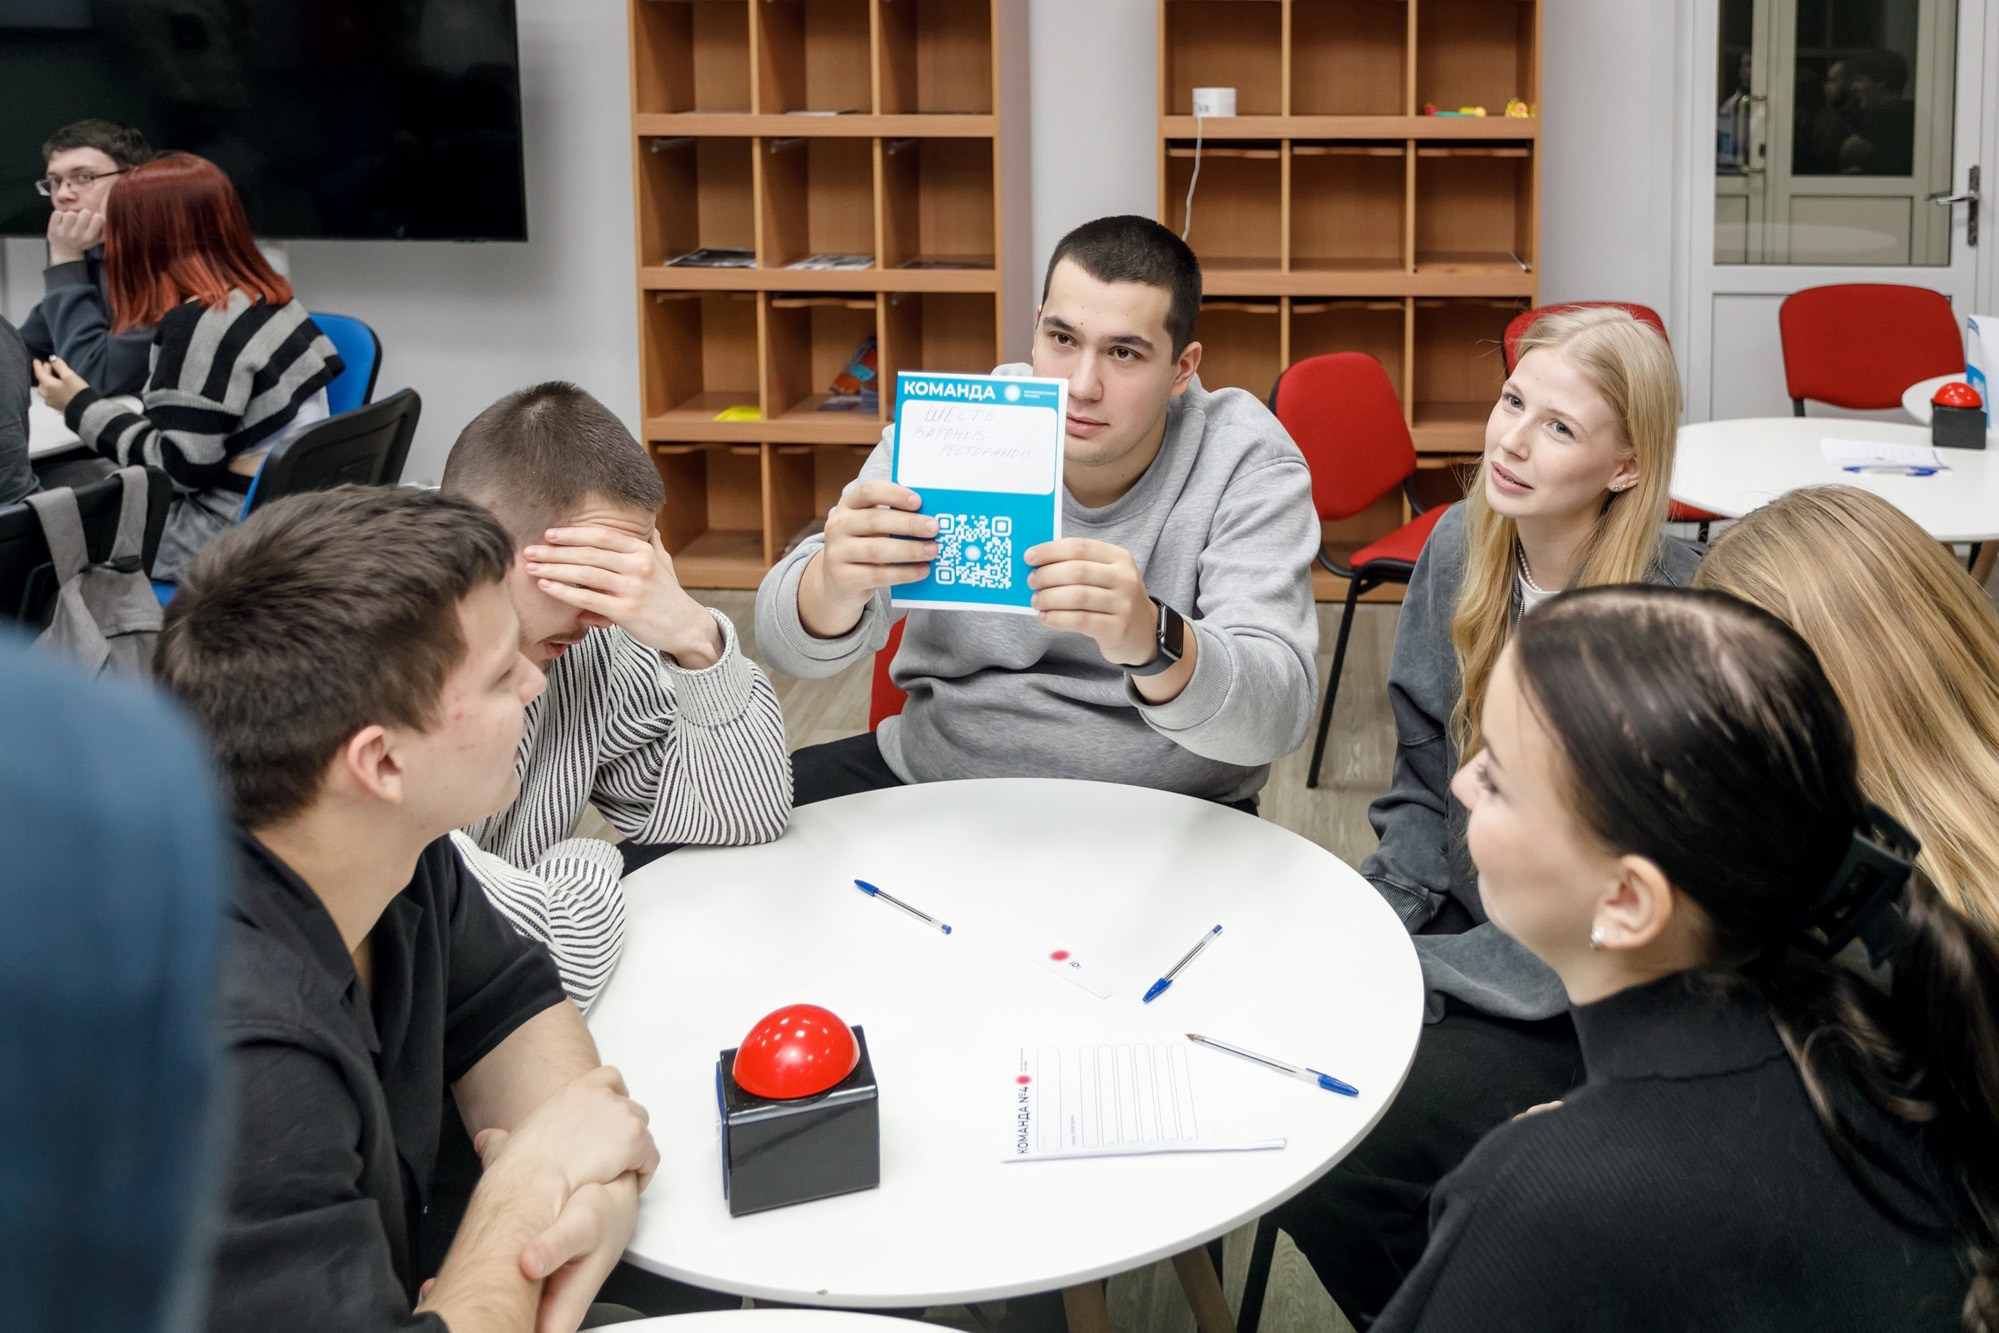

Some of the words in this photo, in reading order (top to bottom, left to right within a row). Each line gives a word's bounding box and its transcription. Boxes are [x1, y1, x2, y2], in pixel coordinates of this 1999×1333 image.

[904, 381, 995, 400] КОМАНДА
[924, 405, 995, 423] ШЕСТЬ
[1018, 1086, 1030, 1103] №4
[1017, 1105, 1031, 1154] КОМАНДА
